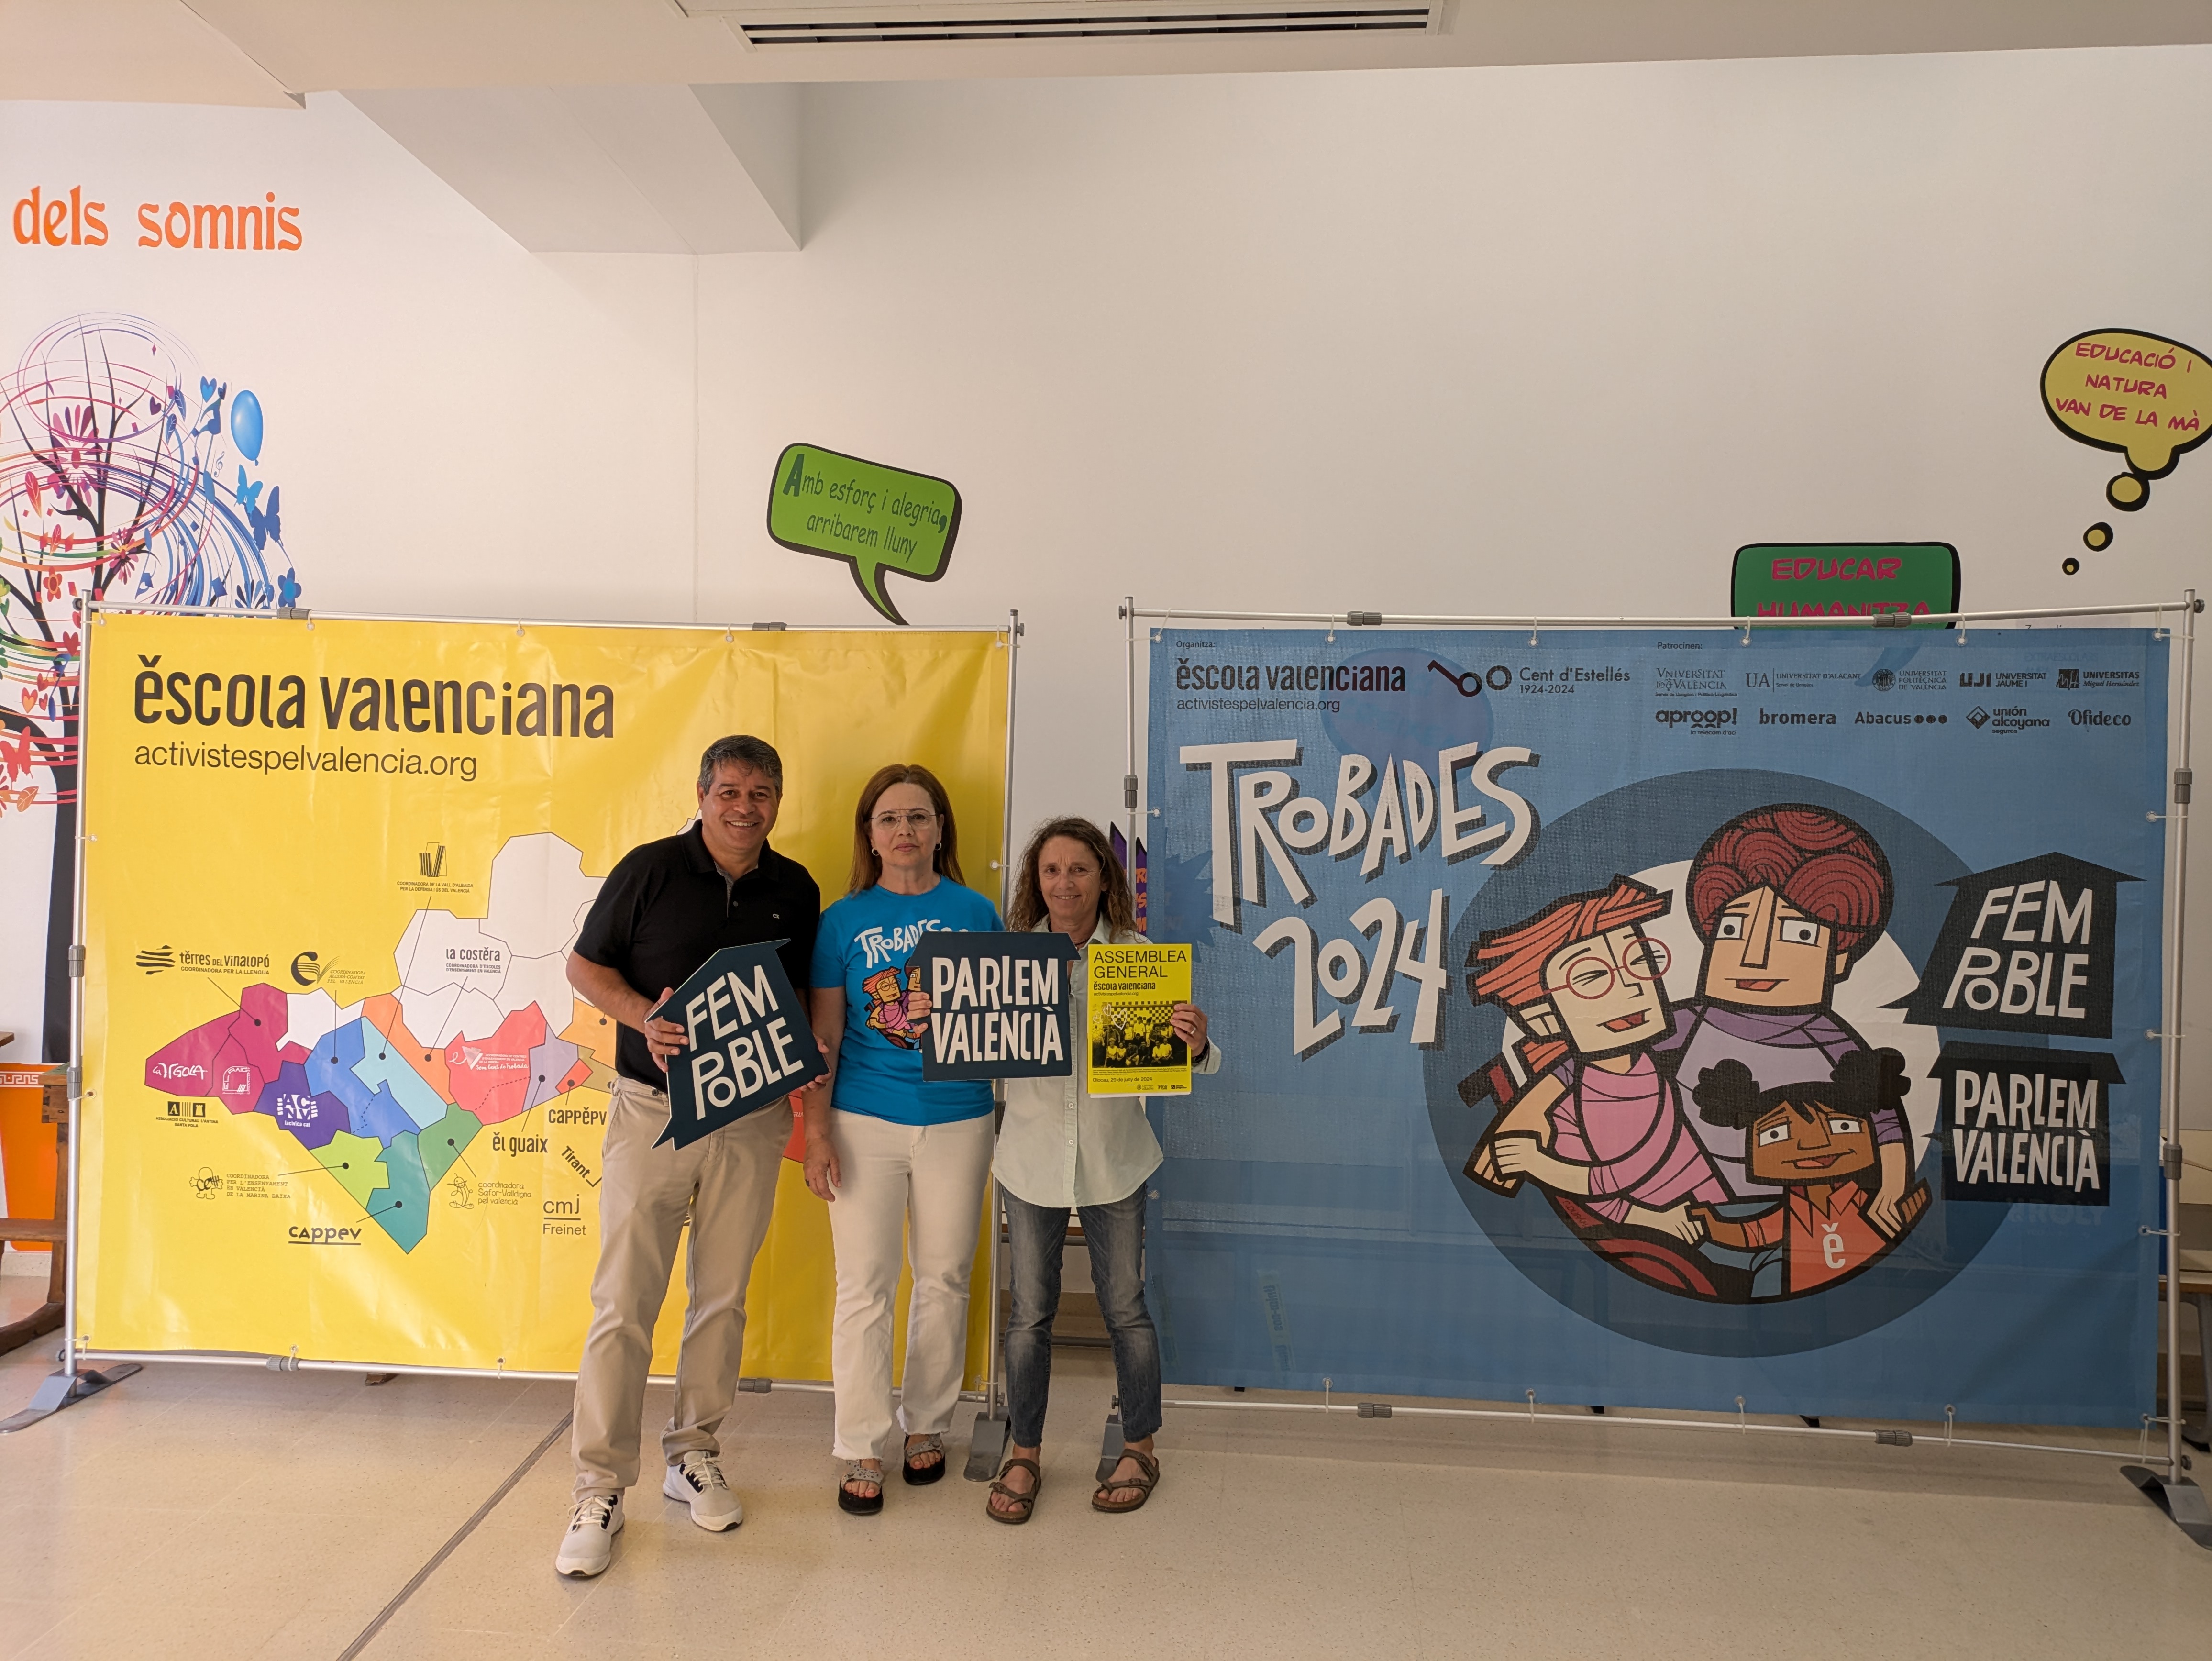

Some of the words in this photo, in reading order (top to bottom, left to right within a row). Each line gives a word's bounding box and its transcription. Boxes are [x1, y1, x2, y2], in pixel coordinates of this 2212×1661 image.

[13, 185, 108, 246] dels
[138, 192, 302, 251] somnis
[2075, 343, 2176, 369] EDUCACIÓ
[2085, 374, 2167, 399] NATURA
[2056, 398, 2091, 416] VAN
[2099, 404, 2127, 420] DE
[2135, 410, 2157, 427] LA
[2168, 410, 2199, 431] MÀ
[782, 454, 823, 497] Amb
[830, 479, 877, 514] esforç
[882, 489, 888, 511] i
[892, 492, 947, 533] alegria,
[807, 513, 878, 548] arribarem
[884, 526, 918, 563] lluny
[1772, 558, 1902, 580] EDUCAR
[1176, 641, 1215, 649] Organitza:
[1265, 665, 1405, 692] valenciana
[1519, 667, 1554, 681] Cent
[1560, 666, 1630, 682] d'Estellés
[1673, 679, 1727, 689] VALÈNCIA
[1746, 673, 1771, 687] UA
[1520, 685, 1575, 694] 1924-2024
[319, 675, 614, 739] valenciana
[1177, 697, 1340, 712] activistespelvalencia.org
[1759, 708, 1836, 724] bromera
[1993, 706, 2026, 716] unión
[1854, 711, 1912, 724] Abacus
[1992, 718, 2050, 730] alcoyana
[2068, 709, 2131, 726] Ofideco
[135, 741, 477, 782] activistespelvalencia.org
[1179, 739, 1535, 930] TROBADES
[1970, 880, 2092, 945] FEM
[446, 948, 455, 959] la
[1093, 950, 1187, 963] ASSEMBLEA
[932, 956, 1059, 1010] PARLEM
[1094, 965, 1168, 978] GENERAL
[1252, 888, 1449, 1057] 2024
[1942, 947, 2089, 1019] POBLE
[1118, 982, 1156, 990] valenciana
[686, 965, 779, 1052] FEM
[931, 1007, 1063, 1065] VALENCIÀ
[692, 1017, 804, 1121] POBLE
[1955, 1069, 2098, 1130] PARLEM
[509, 1134, 549, 1157] guaix
[561, 1145, 590, 1179] Tirant
[1952, 1129, 2100, 1192] VALENCIÀ
[478, 1181, 524, 1189] coordinadora
[478, 1189, 532, 1198] Safor-Valldigna
[543, 1194, 580, 1214] cmj
[543, 1223, 586, 1235] Freinet
